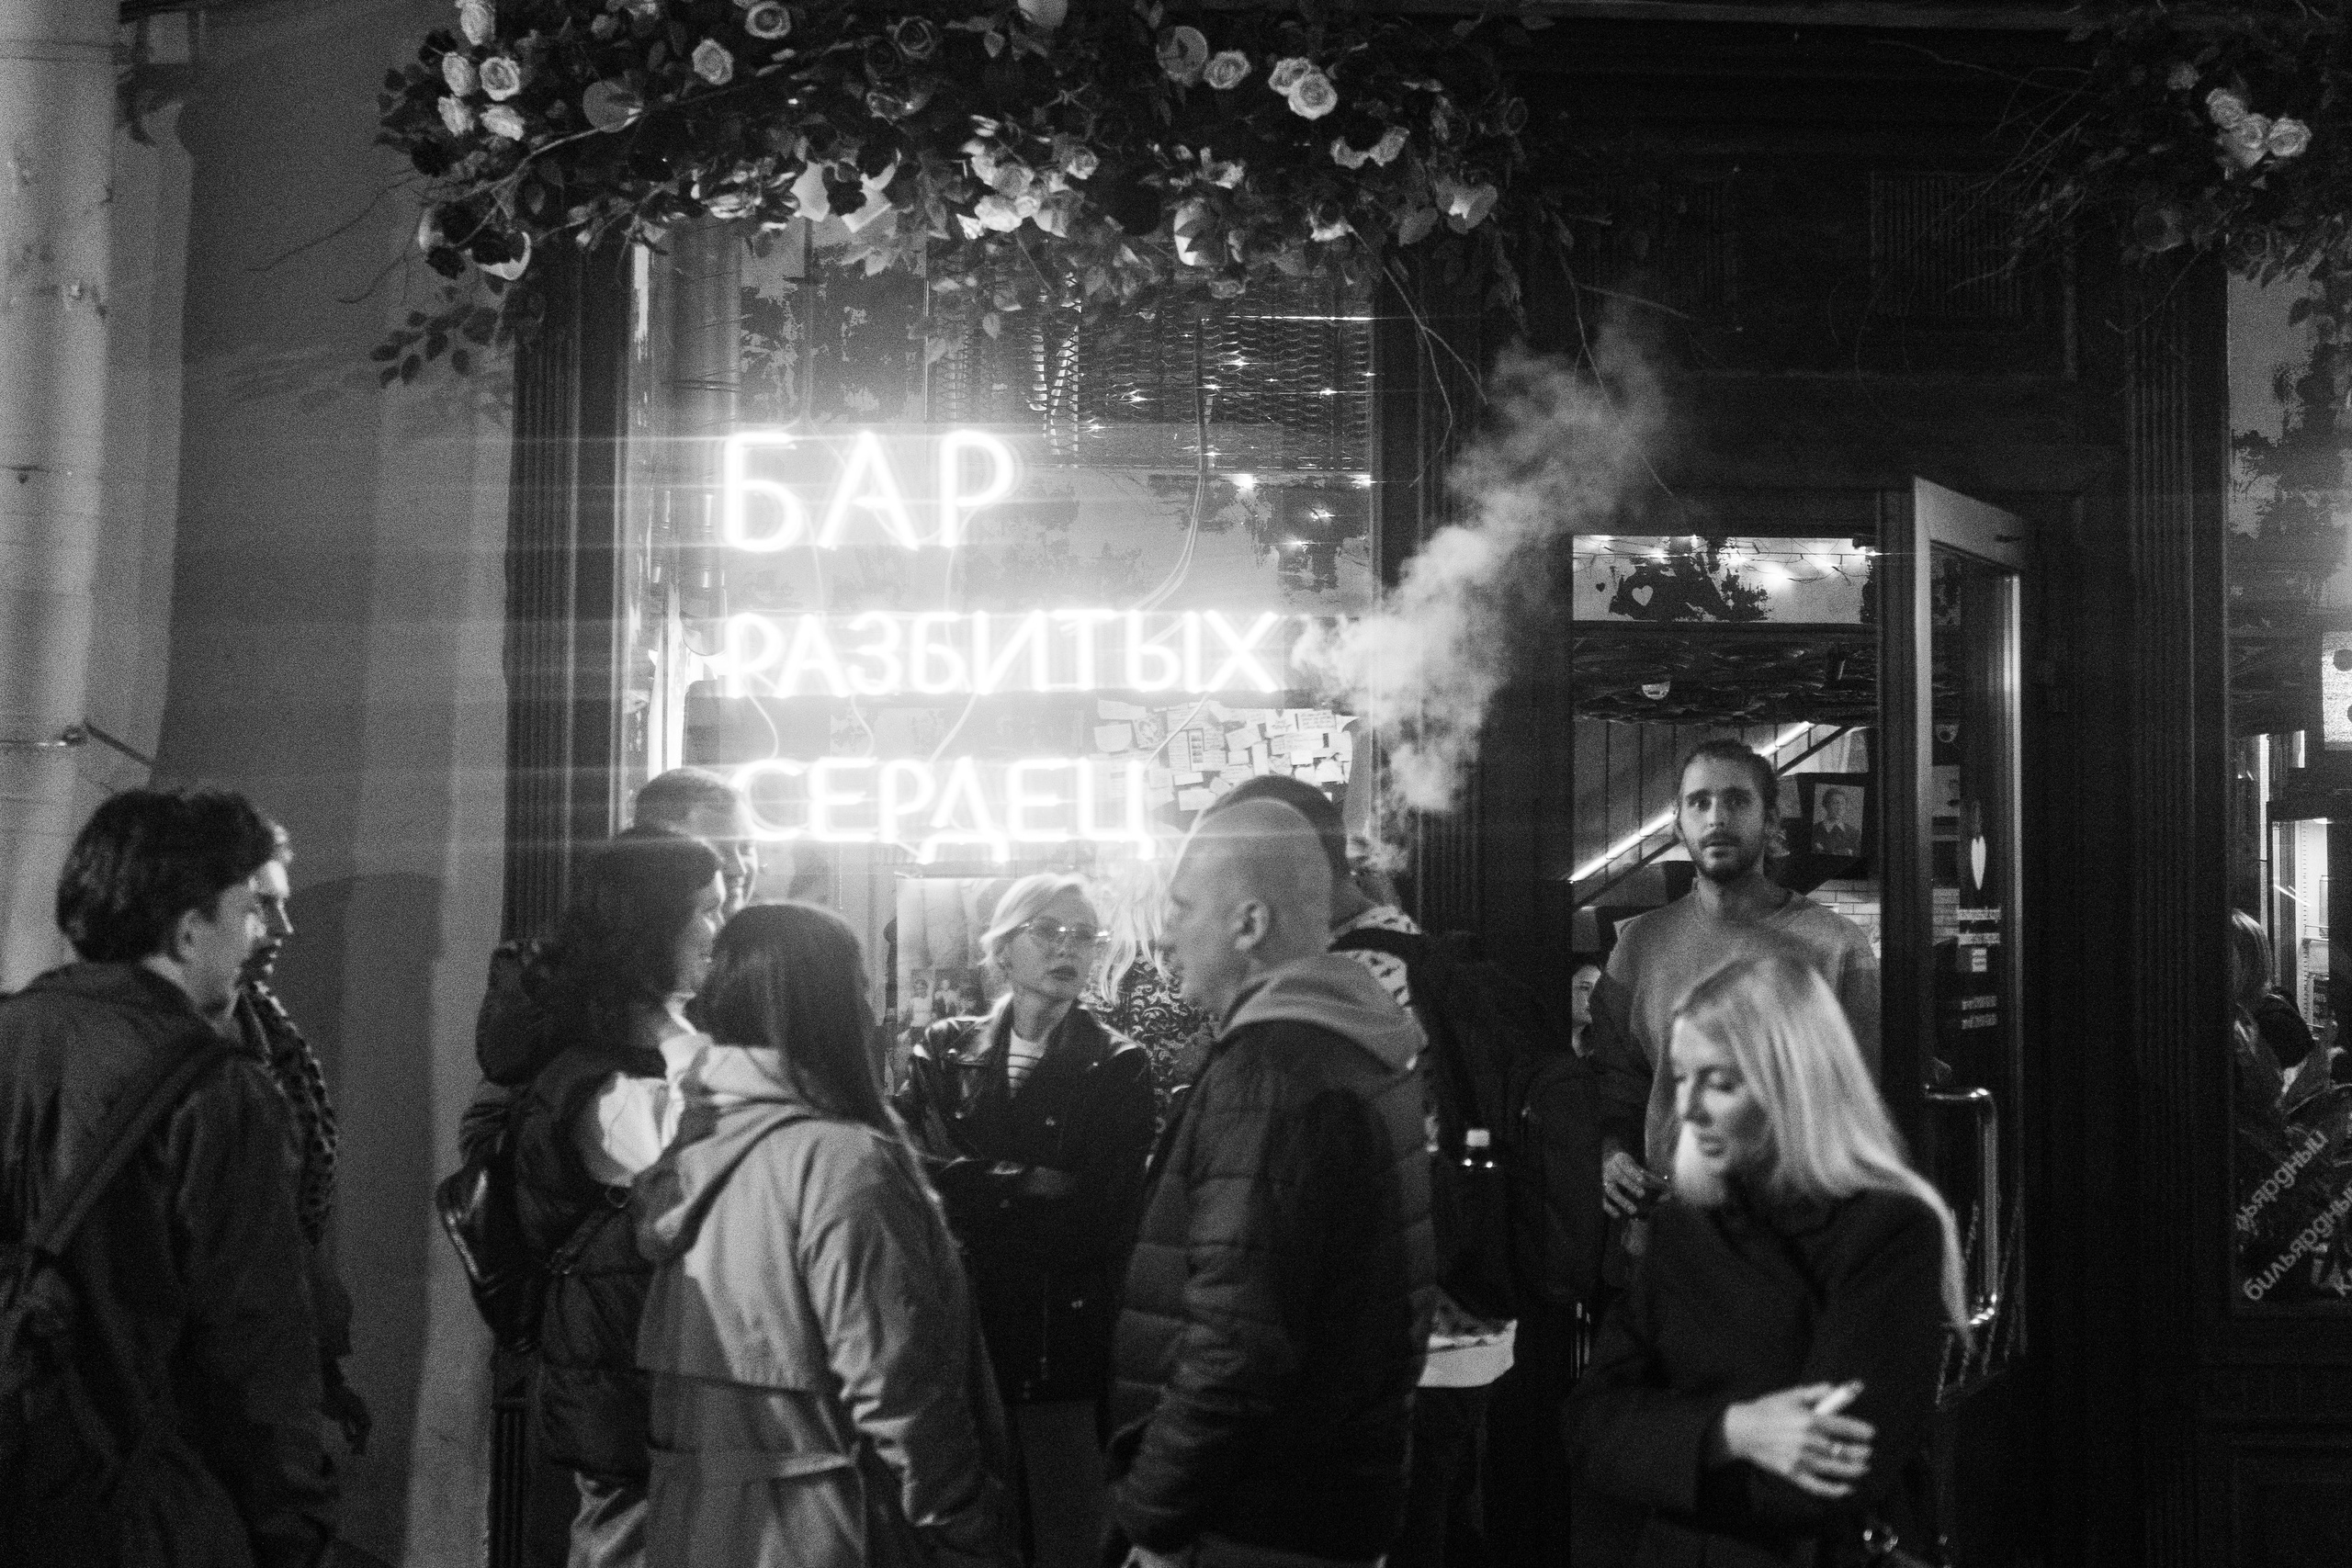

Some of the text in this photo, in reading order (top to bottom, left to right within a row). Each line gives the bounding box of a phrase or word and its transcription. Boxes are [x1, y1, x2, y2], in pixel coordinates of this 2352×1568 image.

[721, 429, 1016, 551] БАР
[724, 609, 1279, 698] РАЗБИТЫХ
[735, 756, 1157, 864] СЕРДЕЦ
